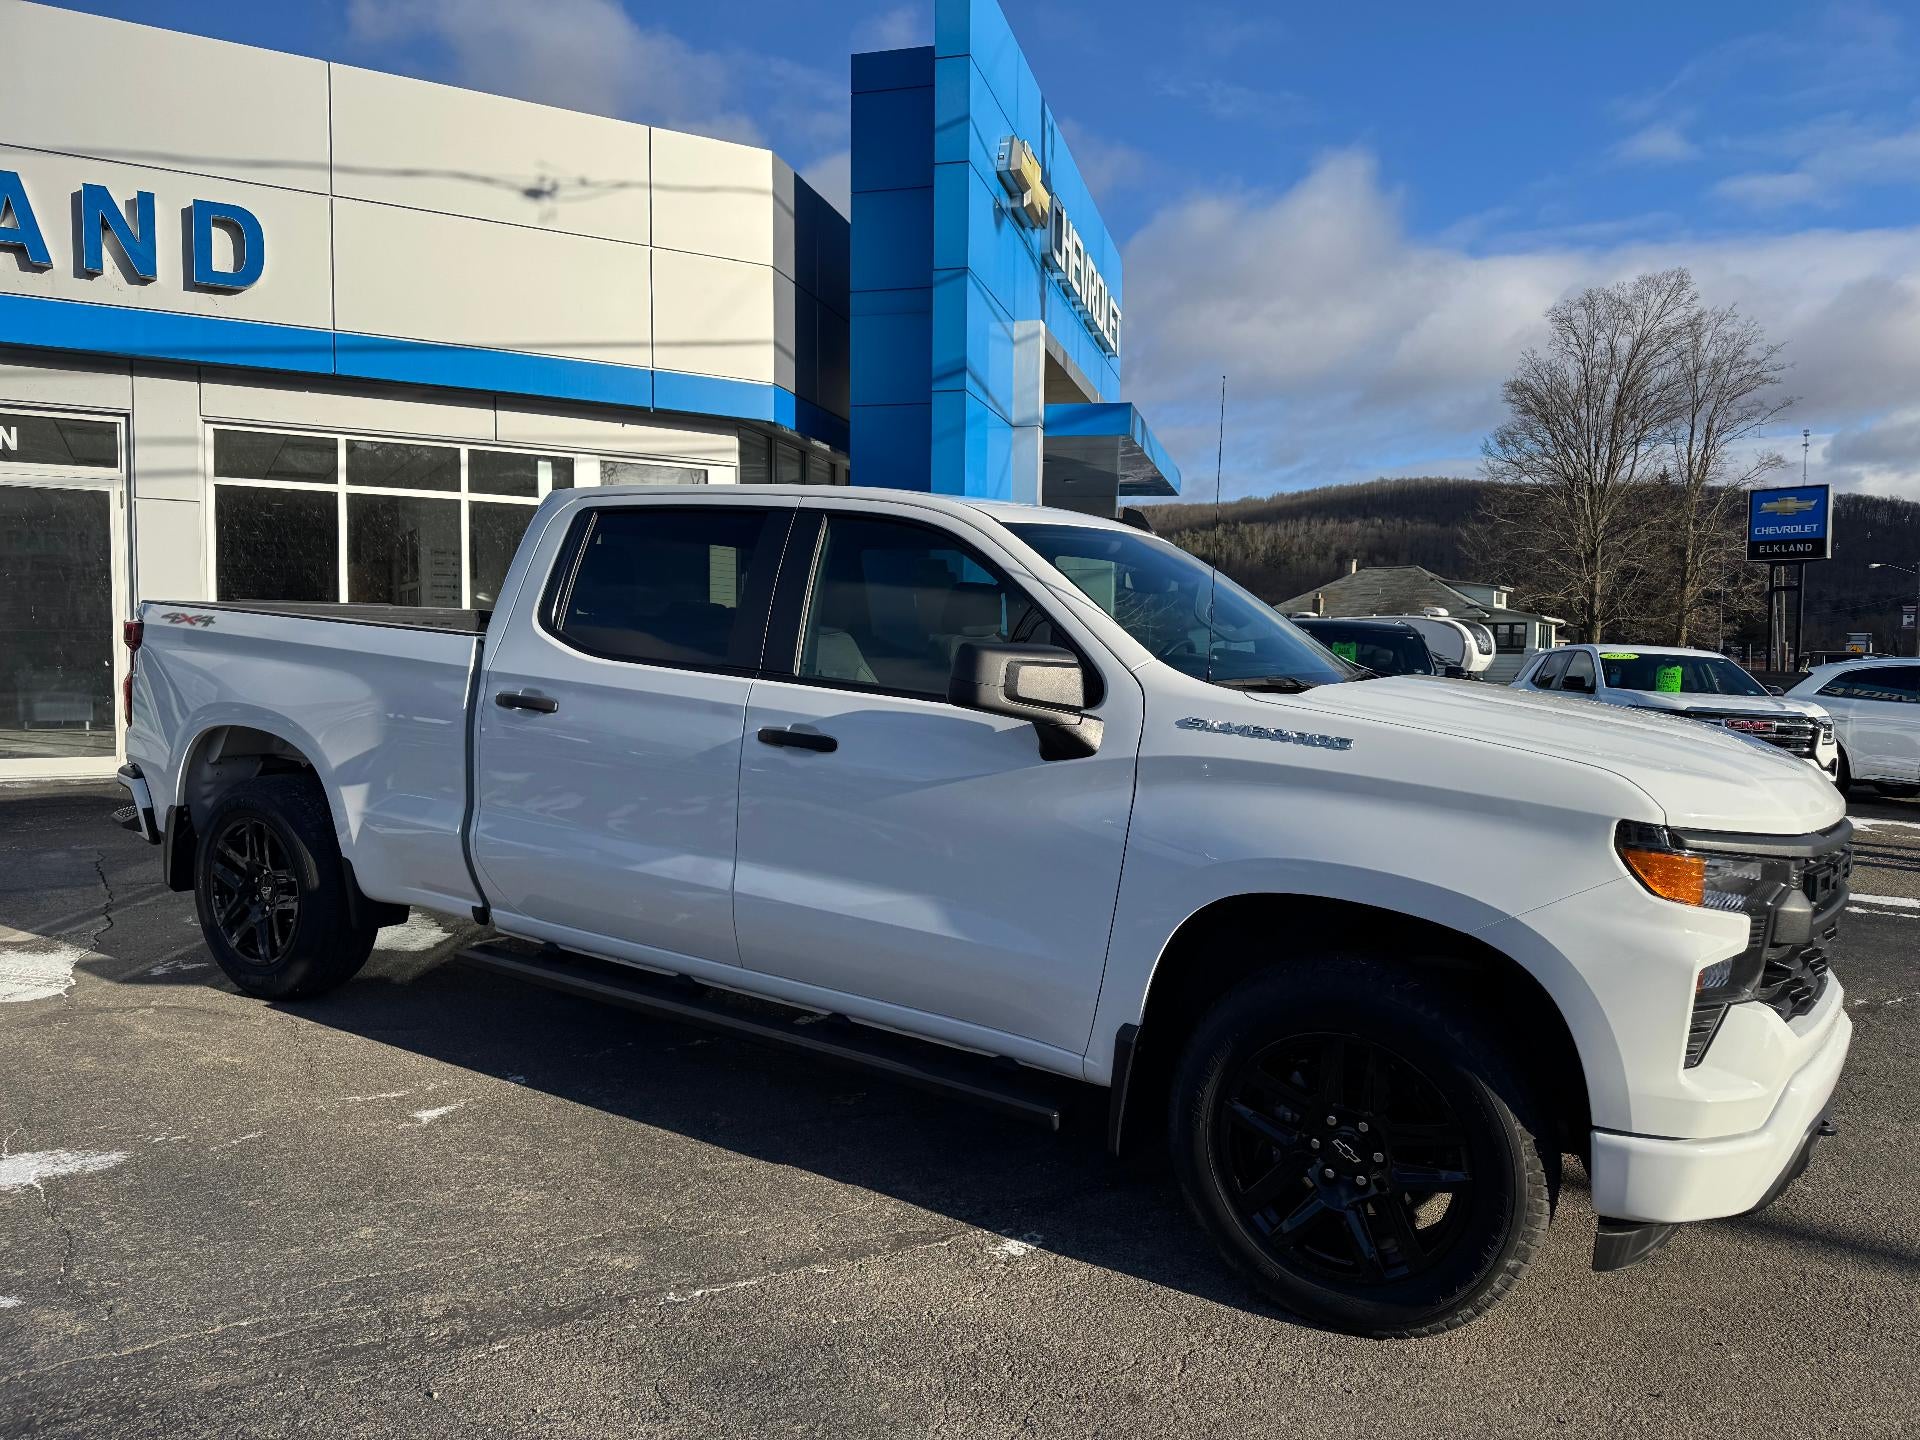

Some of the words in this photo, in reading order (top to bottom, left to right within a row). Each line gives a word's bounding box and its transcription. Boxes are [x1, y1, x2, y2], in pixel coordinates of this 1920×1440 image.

[1050, 192, 1121, 358] CHEVROLET
[1754, 523, 1819, 535] CHEVROLET
[1759, 543, 1813, 553] ELKLAND
